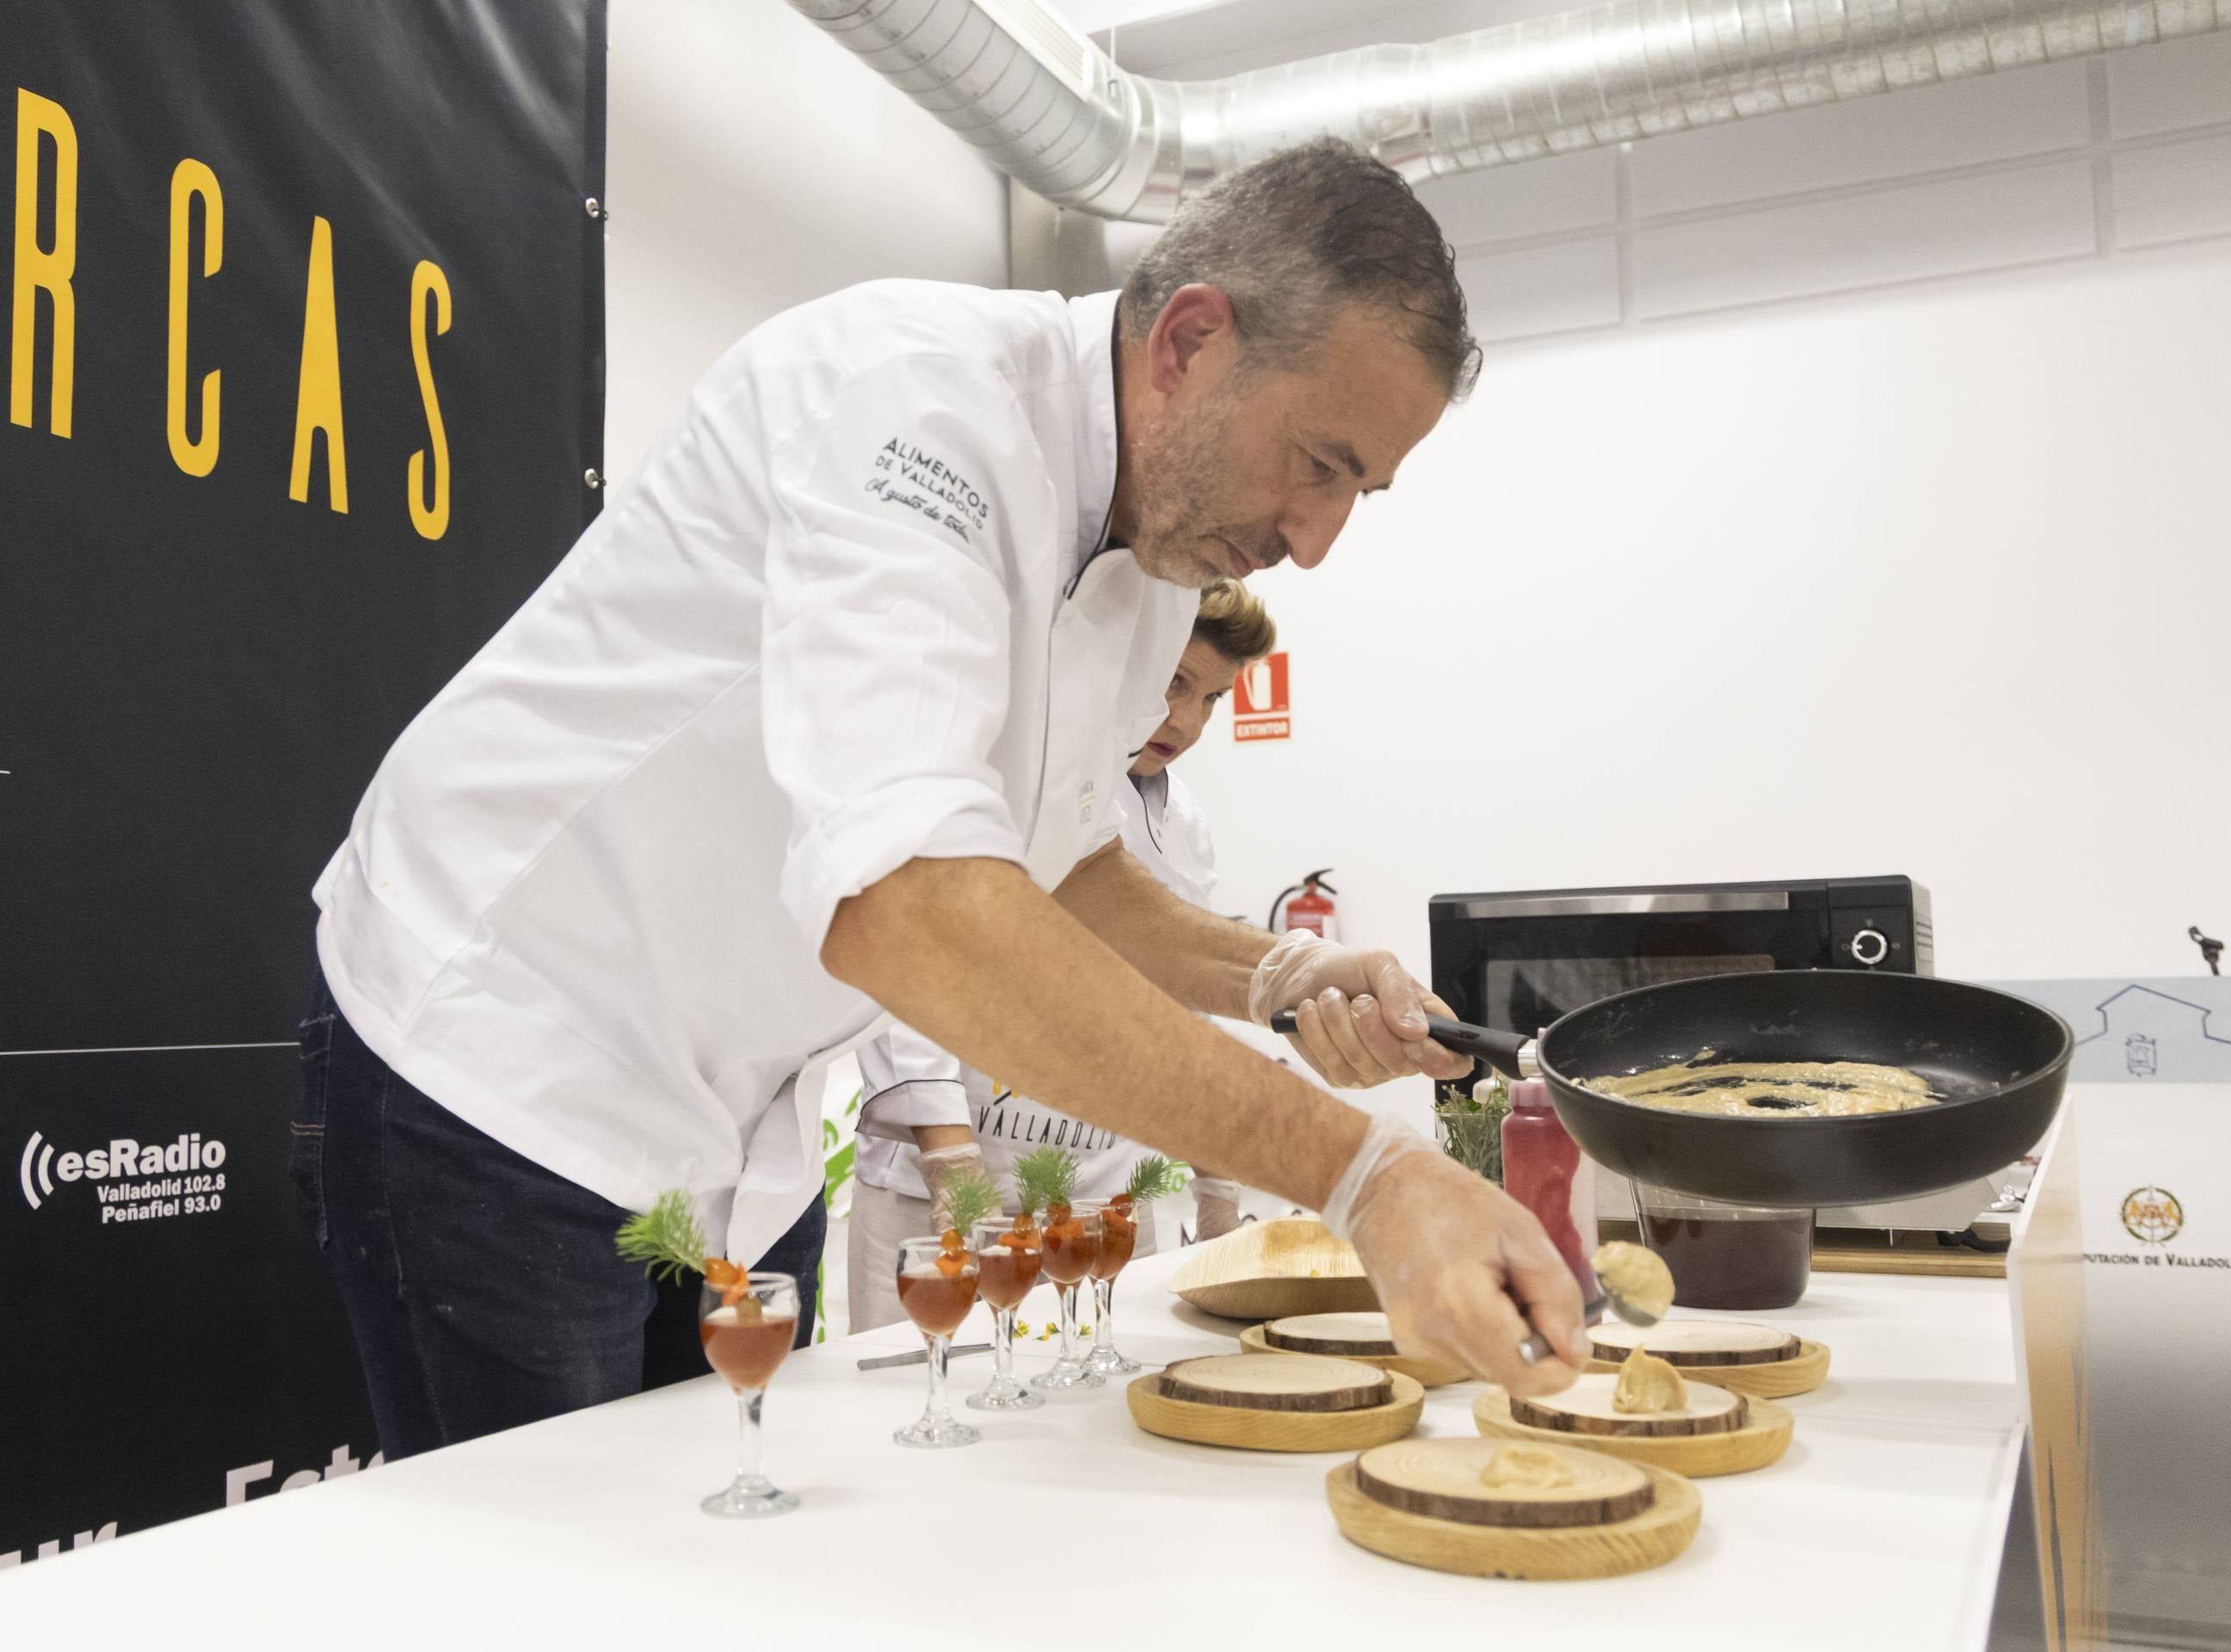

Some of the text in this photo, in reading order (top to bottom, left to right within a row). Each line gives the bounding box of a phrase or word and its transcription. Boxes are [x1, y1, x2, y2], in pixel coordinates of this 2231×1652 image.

[874, 455, 983, 530] DE VALLADOLID
[883, 437, 989, 518] ALIMENTOS
[881, 488, 928, 509] gusto
[923, 506, 941, 521] de
[978, 1106, 1117, 1150] VALLADOLID
[57, 1132, 226, 1182] esRadio
[96, 1173, 226, 1204] Valladolid 102.8
[102, 1194, 221, 1224] Peñafiel 93.0
[2144, 1255, 2160, 1266] DE
